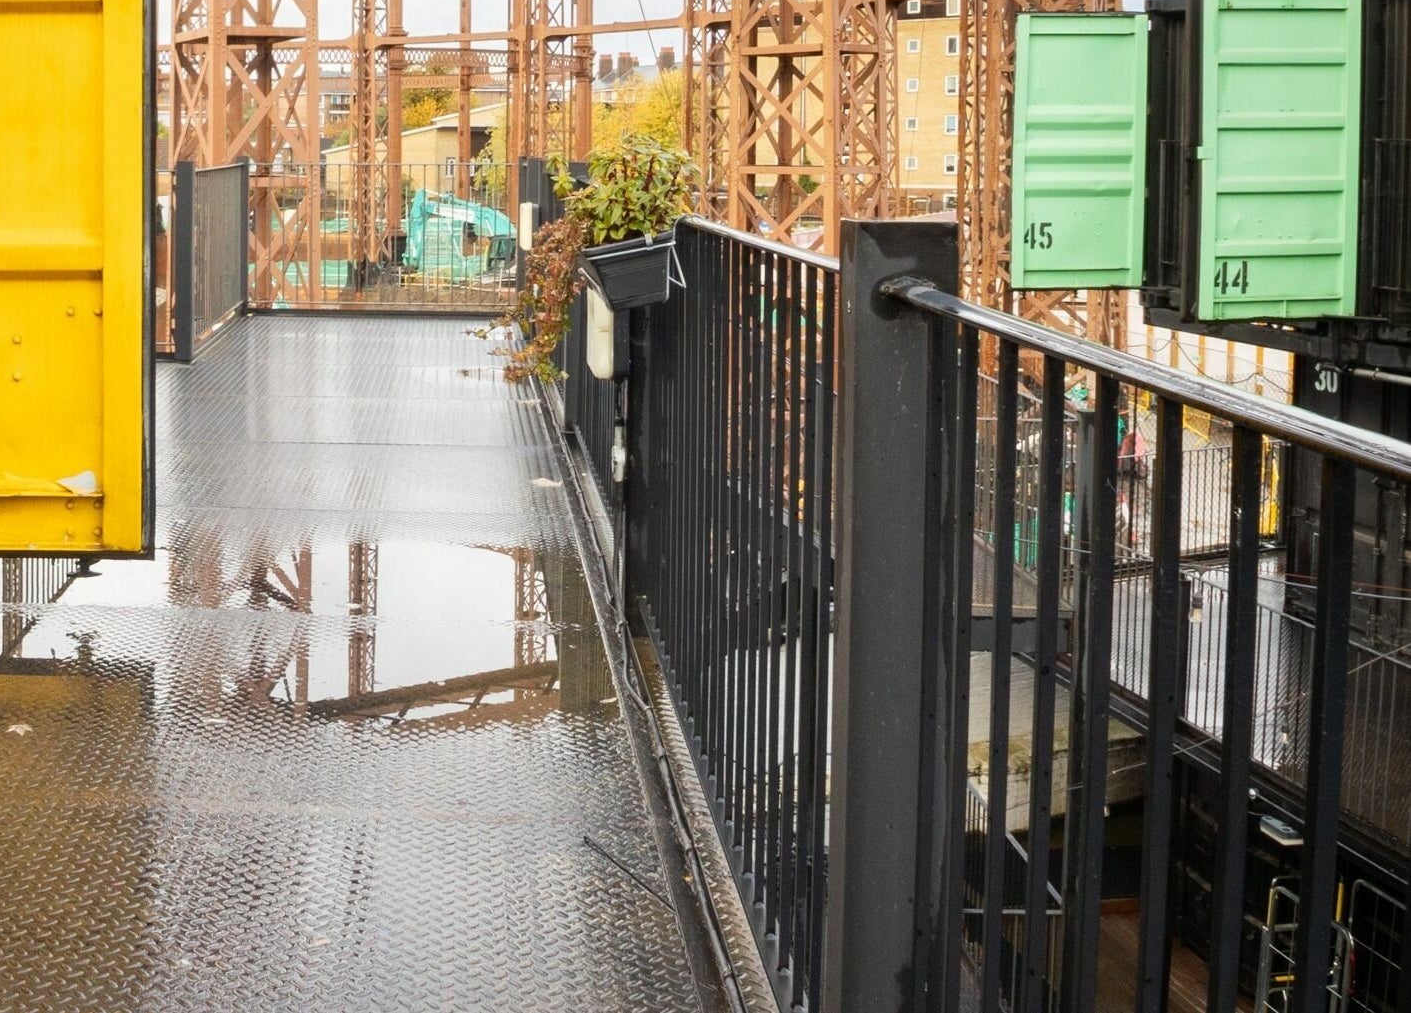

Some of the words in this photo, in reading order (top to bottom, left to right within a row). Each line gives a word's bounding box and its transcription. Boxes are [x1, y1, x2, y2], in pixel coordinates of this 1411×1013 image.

[1023, 222, 1053, 250] 45
[1214, 260, 1249, 295] 44
[1315, 363, 1338, 393] 30
